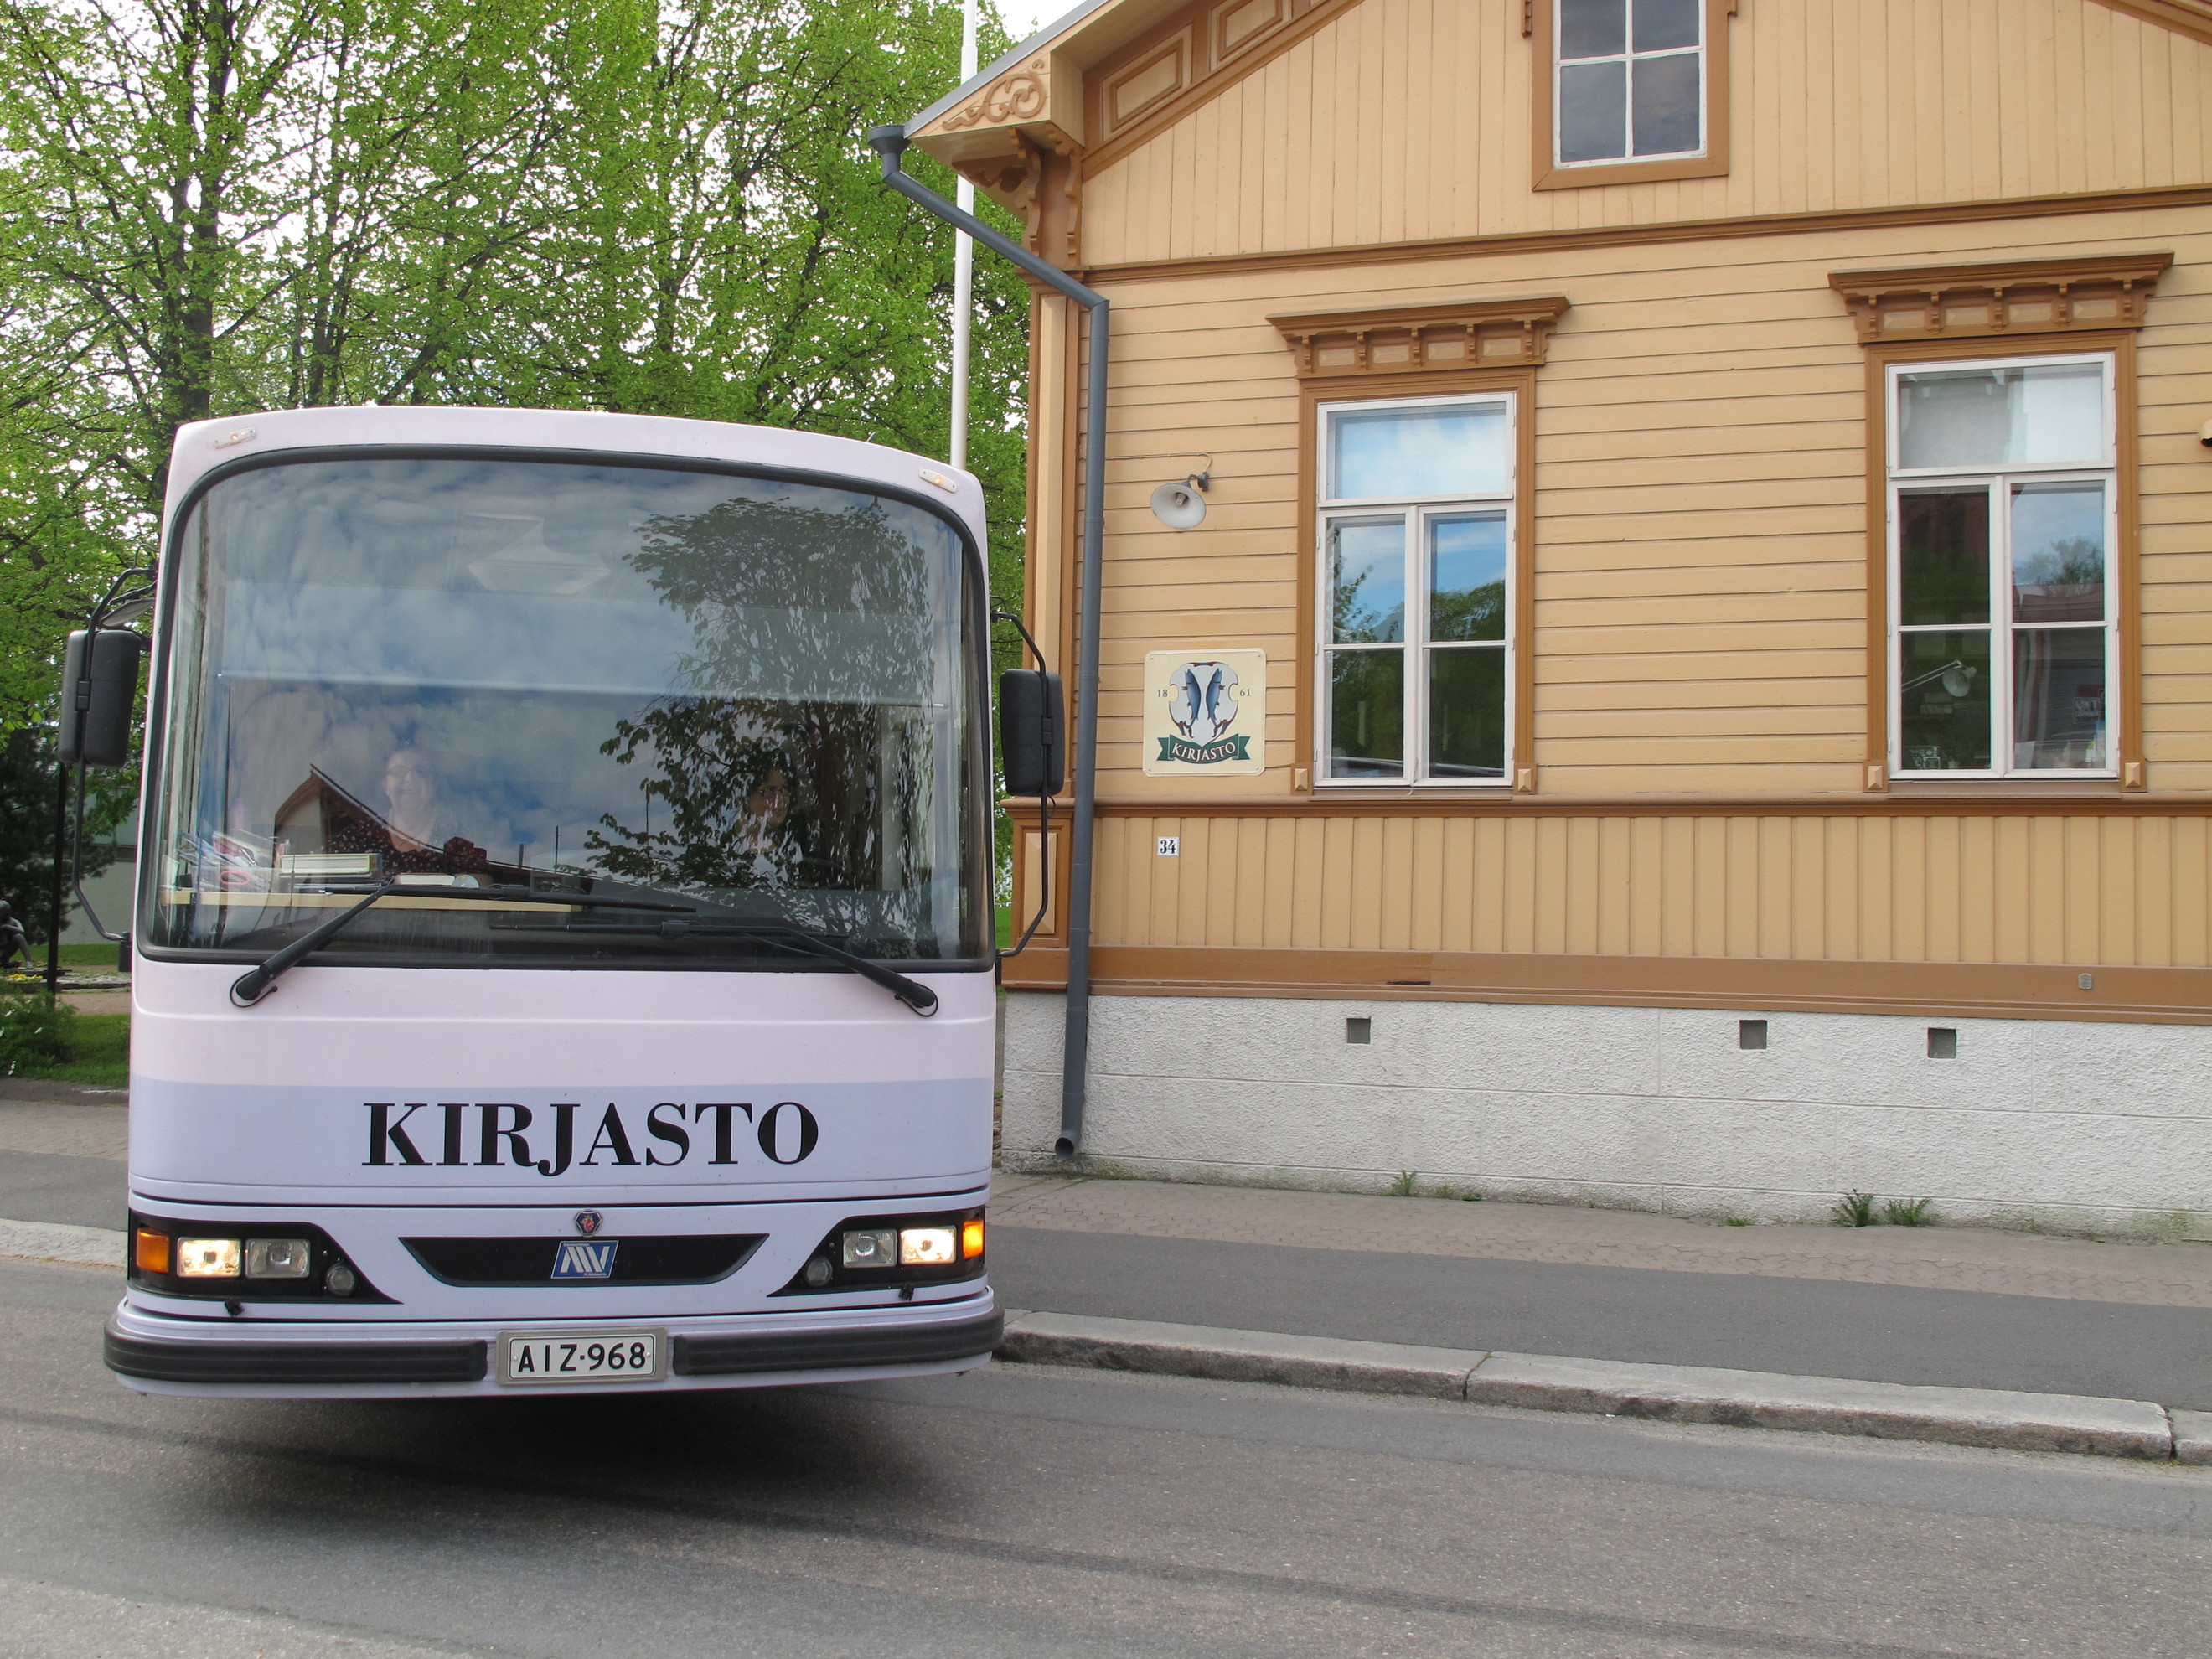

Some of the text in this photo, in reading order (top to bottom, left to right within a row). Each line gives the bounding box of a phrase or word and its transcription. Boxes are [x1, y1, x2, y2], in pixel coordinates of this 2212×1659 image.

[1157, 688, 1251, 698] 18 61
[1171, 741, 1237, 762] KIRJASTO
[1160, 839, 1176, 854] 34
[362, 1101, 819, 1176] KIRJASTO
[518, 1341, 646, 1372] AIZ-968
